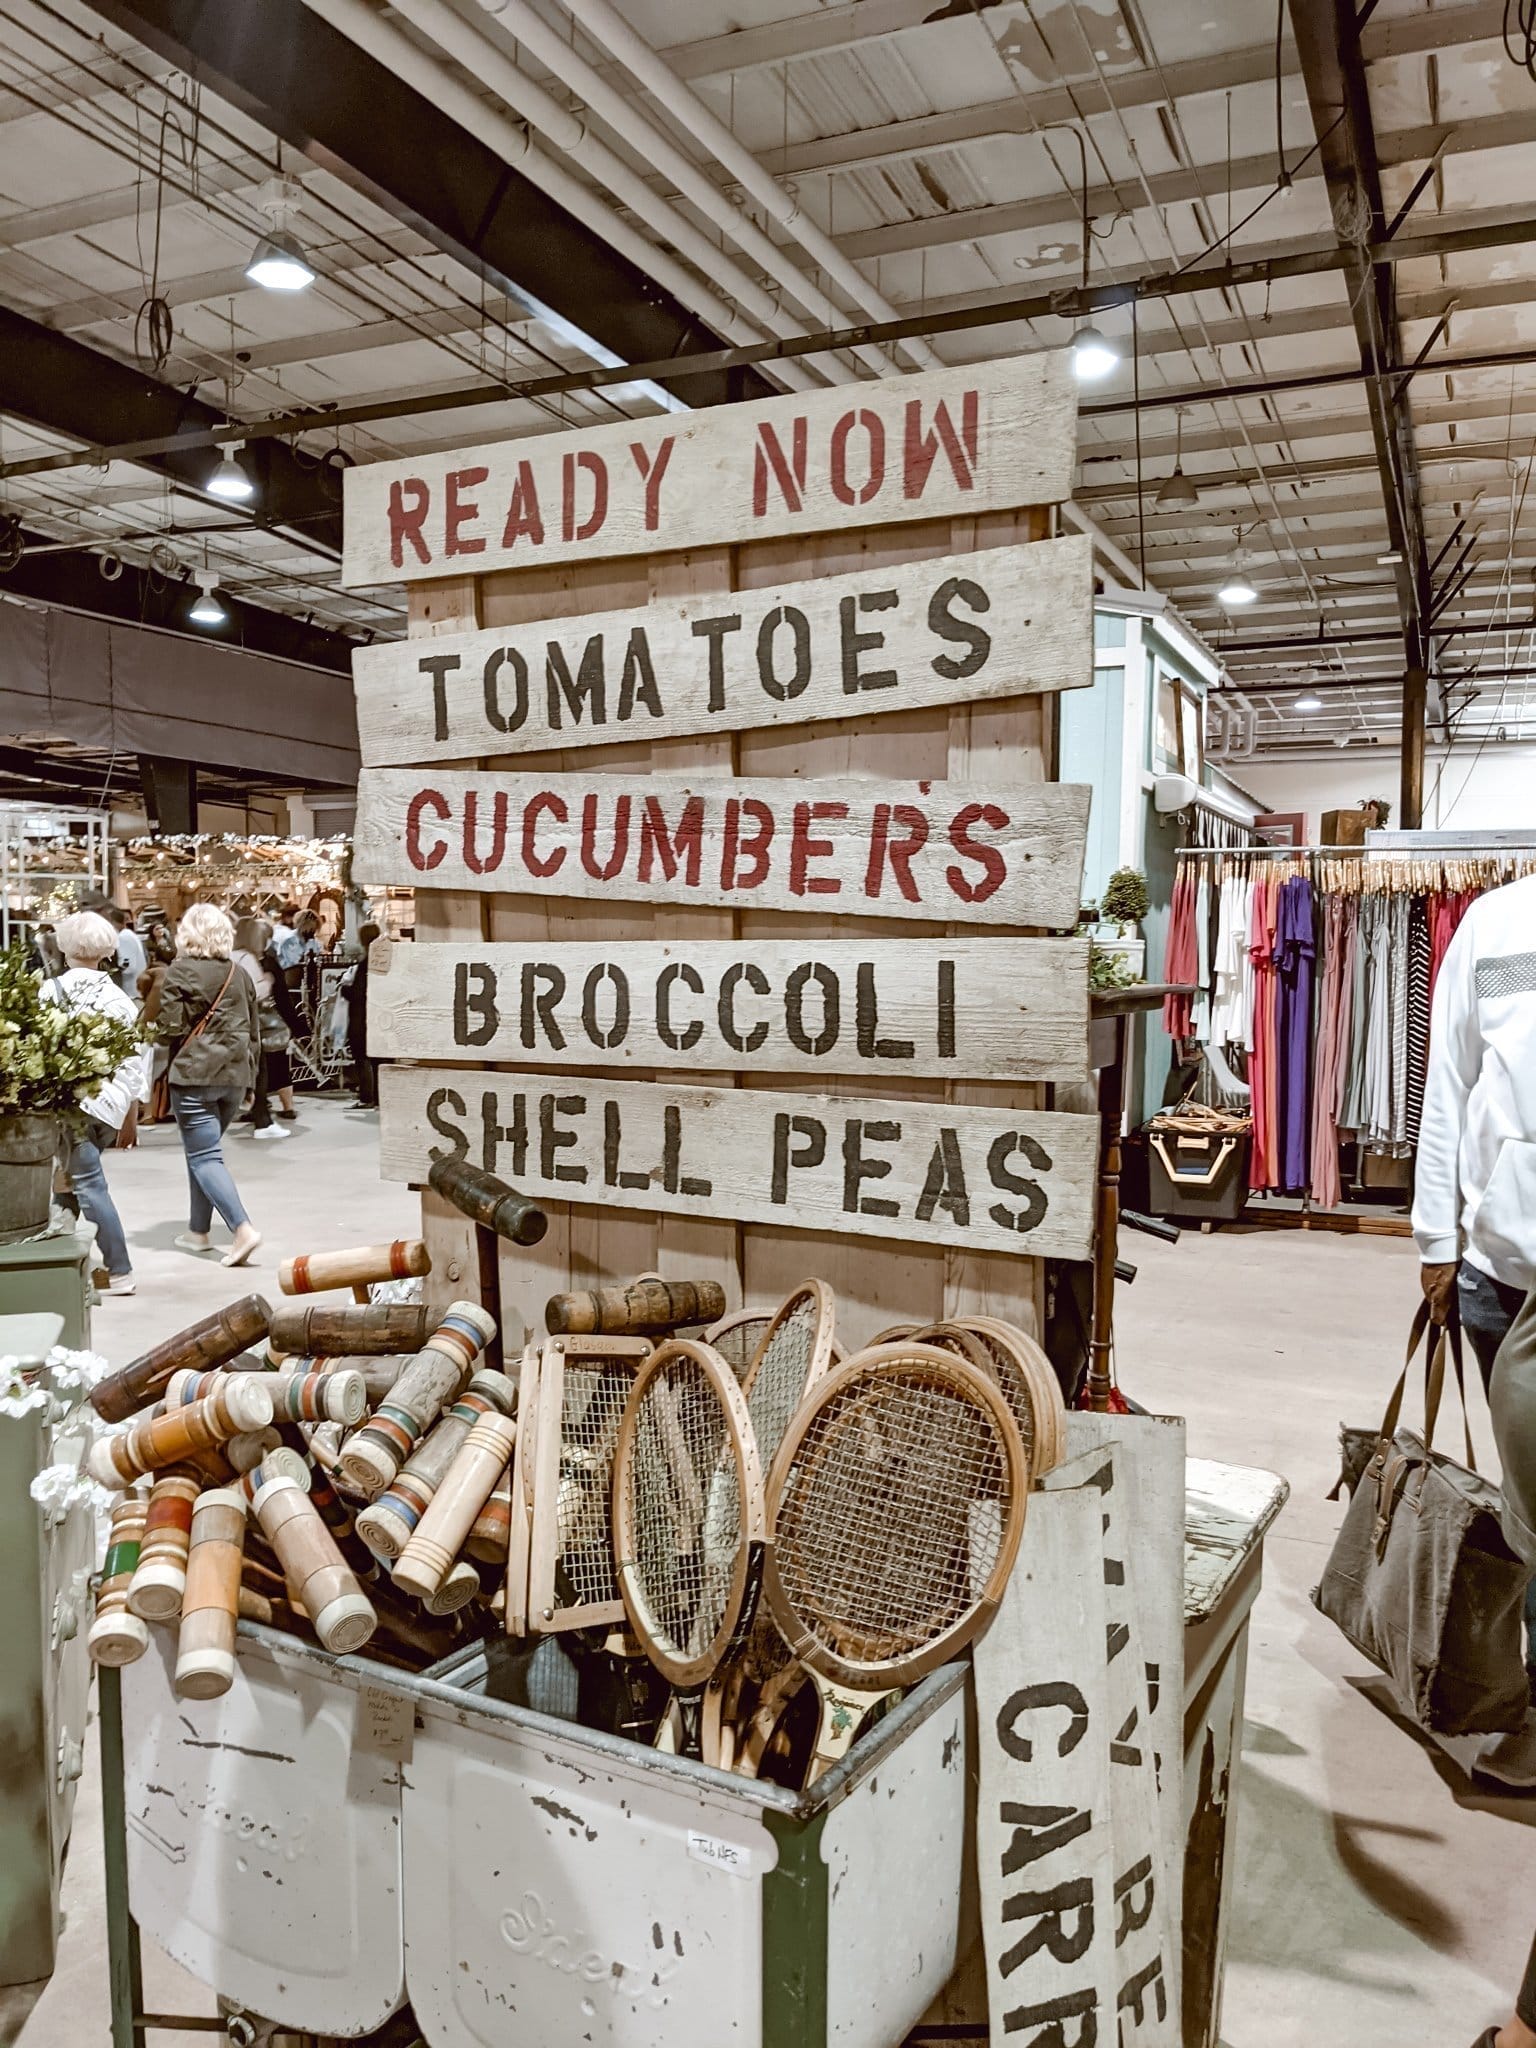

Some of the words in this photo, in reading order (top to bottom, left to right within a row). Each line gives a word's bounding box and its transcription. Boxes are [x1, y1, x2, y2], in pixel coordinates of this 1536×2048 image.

[387, 436, 675, 568] READY
[753, 390, 979, 517] NOW
[418, 577, 992, 742] TOMATOES
[406, 788, 1010, 903] CUCUMBERS
[453, 960, 957, 1060] BROCCOLI
[426, 1087, 713, 1197] SHELL
[770, 1112, 1054, 1234] PEAS
[996, 1680, 1099, 2048] CARR
